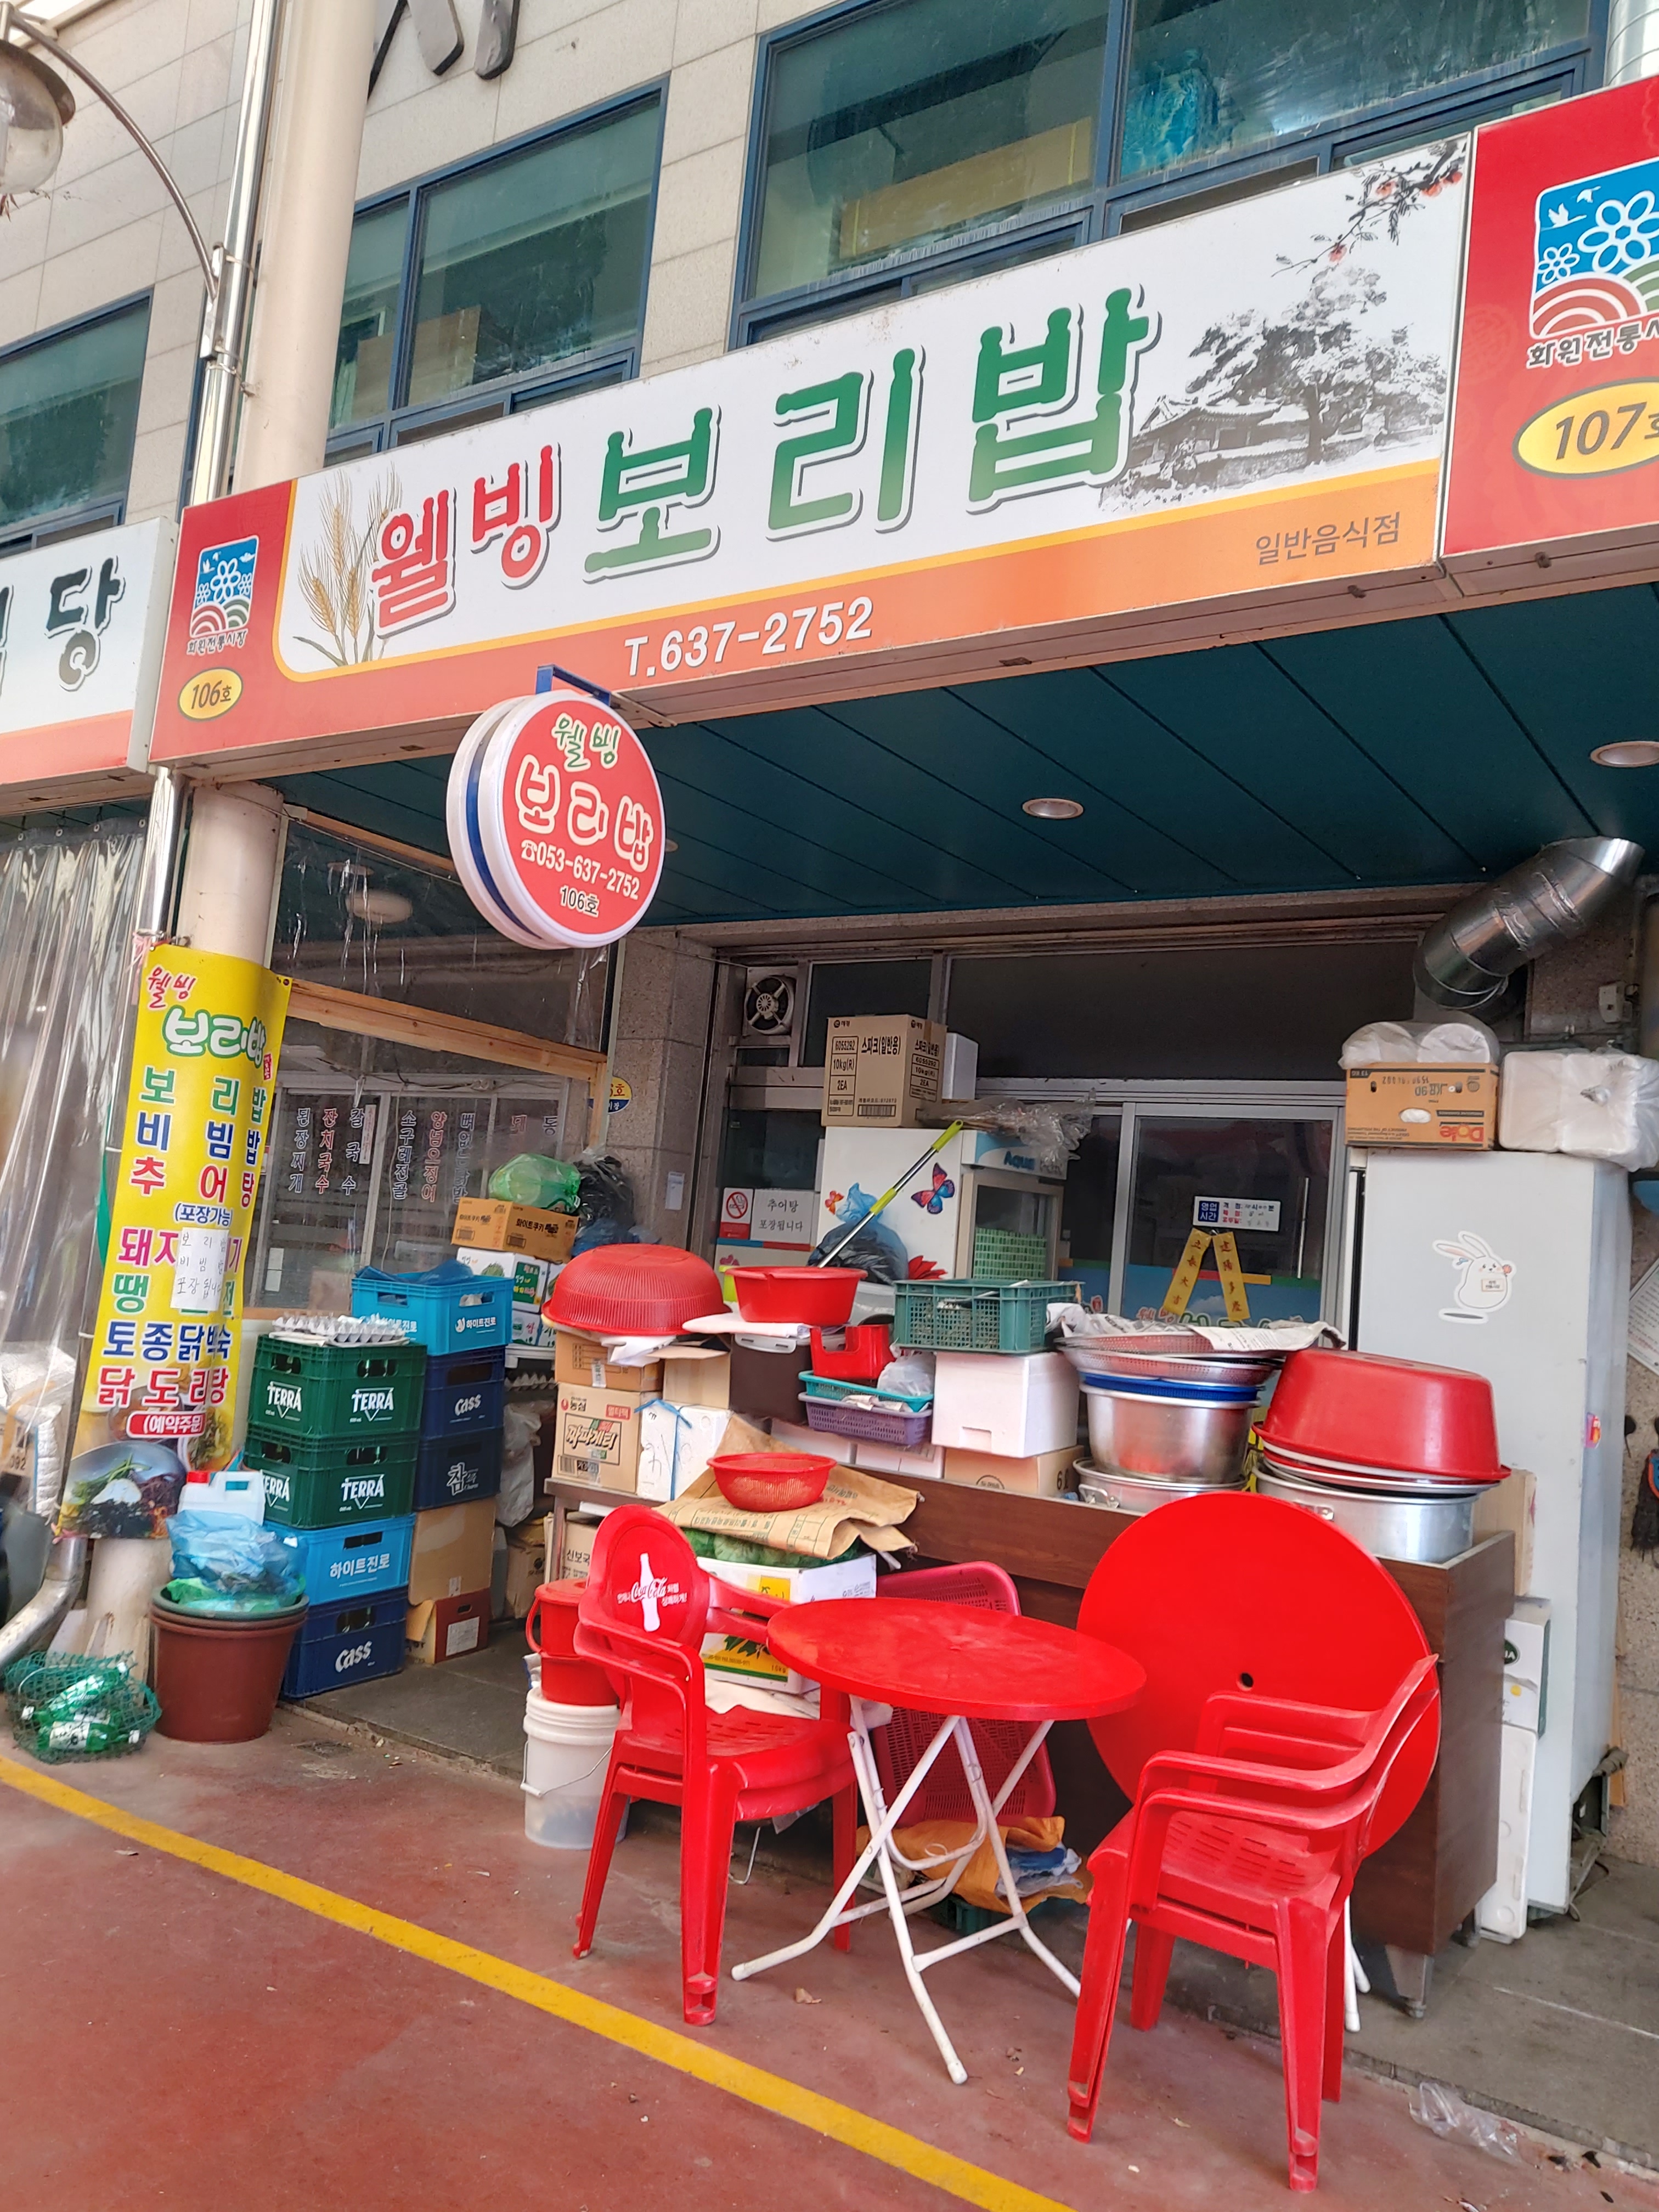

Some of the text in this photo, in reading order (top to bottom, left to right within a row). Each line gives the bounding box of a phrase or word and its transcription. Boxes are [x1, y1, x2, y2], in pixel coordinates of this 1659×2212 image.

[372, 287, 1152, 634] 웰빙 보리밥
[1255, 511, 1402, 565] 일반음식점
[187, 629, 247, 655] 화원전통시장
[624, 596, 874, 678] T.637-2752
[190, 681, 232, 710] 106호
[553, 715, 623, 771] 웰빙
[515, 754, 654, 872] 보리밥
[560, 884, 600, 917] 106호
[148, 966, 196, 1009] 웰빙
[162, 1005, 266, 1068] 보리밥
[861, 1035, 901, 1055] 스파크(일반용)
[833, 1058, 854, 1071] 10kg(R)
[837, 1080, 847, 1090] 2EA
[919, 1079, 929, 1087] 2EA
[1439, 1126, 1484, 1142] Dole
[288, 1108, 311, 1193] 된장찌개
[315, 1108, 338, 1194] 잔치국수
[421, 1111, 447, 1203] 양념오징어
[768, 1198, 799, 1213] 추어탕
[1200, 1212, 1216, 1221] 시간
[1201, 1202, 1217, 1211] 영업
[466, 1317, 496, 1329] 하이트진로
[103, 1321, 232, 1361] 토종닭백숙
[97, 1367, 229, 1407] 닭도리탕
[267, 1381, 302, 1412] TERRA
[352, 1388, 394, 1413] TERRA
[455, 1394, 481, 1416] Cass
[570, 1400, 586, 1412] 농심
[566, 1424, 618, 1450] 짜파게티
[341, 1475, 384, 1502] TERRA
[447, 1462, 468, 1496] 참
[330, 1554, 390, 1579] 하이트진로
[335, 1641, 372, 1672] Cass
